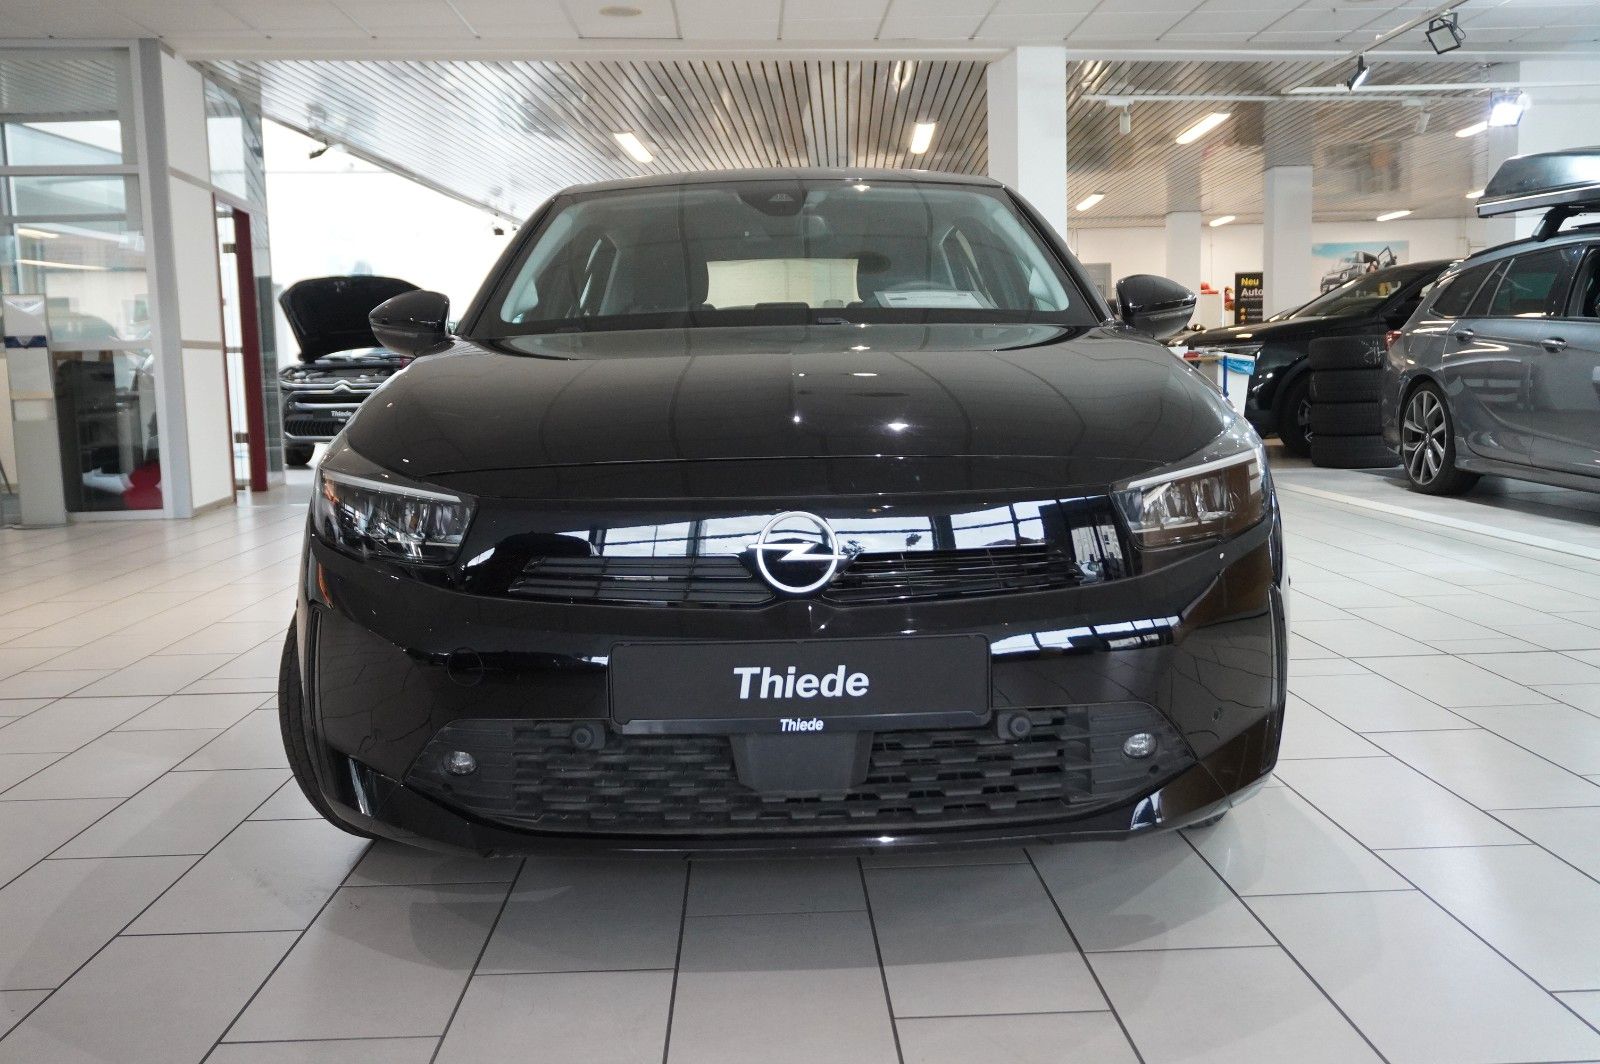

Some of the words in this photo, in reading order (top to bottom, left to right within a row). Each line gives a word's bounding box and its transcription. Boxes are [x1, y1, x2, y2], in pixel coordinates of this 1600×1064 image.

[1241, 277, 1259, 286] Neu
[733, 664, 870, 700] Thiede
[780, 717, 824, 732] Thiede
